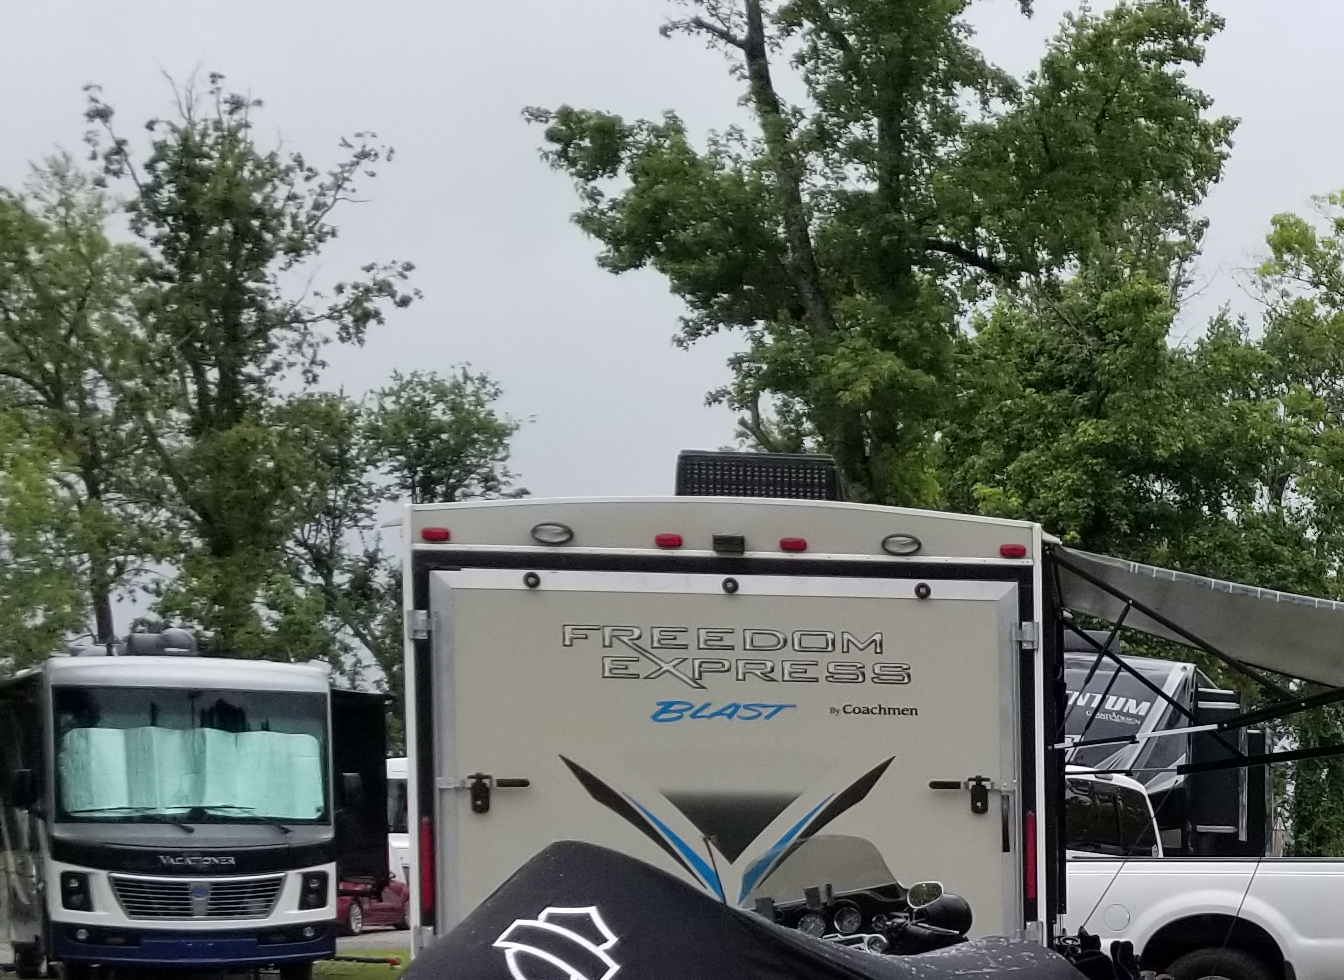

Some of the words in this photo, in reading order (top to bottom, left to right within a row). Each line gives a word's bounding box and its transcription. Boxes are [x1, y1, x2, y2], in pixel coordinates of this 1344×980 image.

[562, 624, 883, 655] FREEDOM
[601, 655, 913, 689] EXPRESS
[650, 700, 797, 723] BLAST
[829, 706, 841, 717] By
[842, 703, 919, 717] Coachmen
